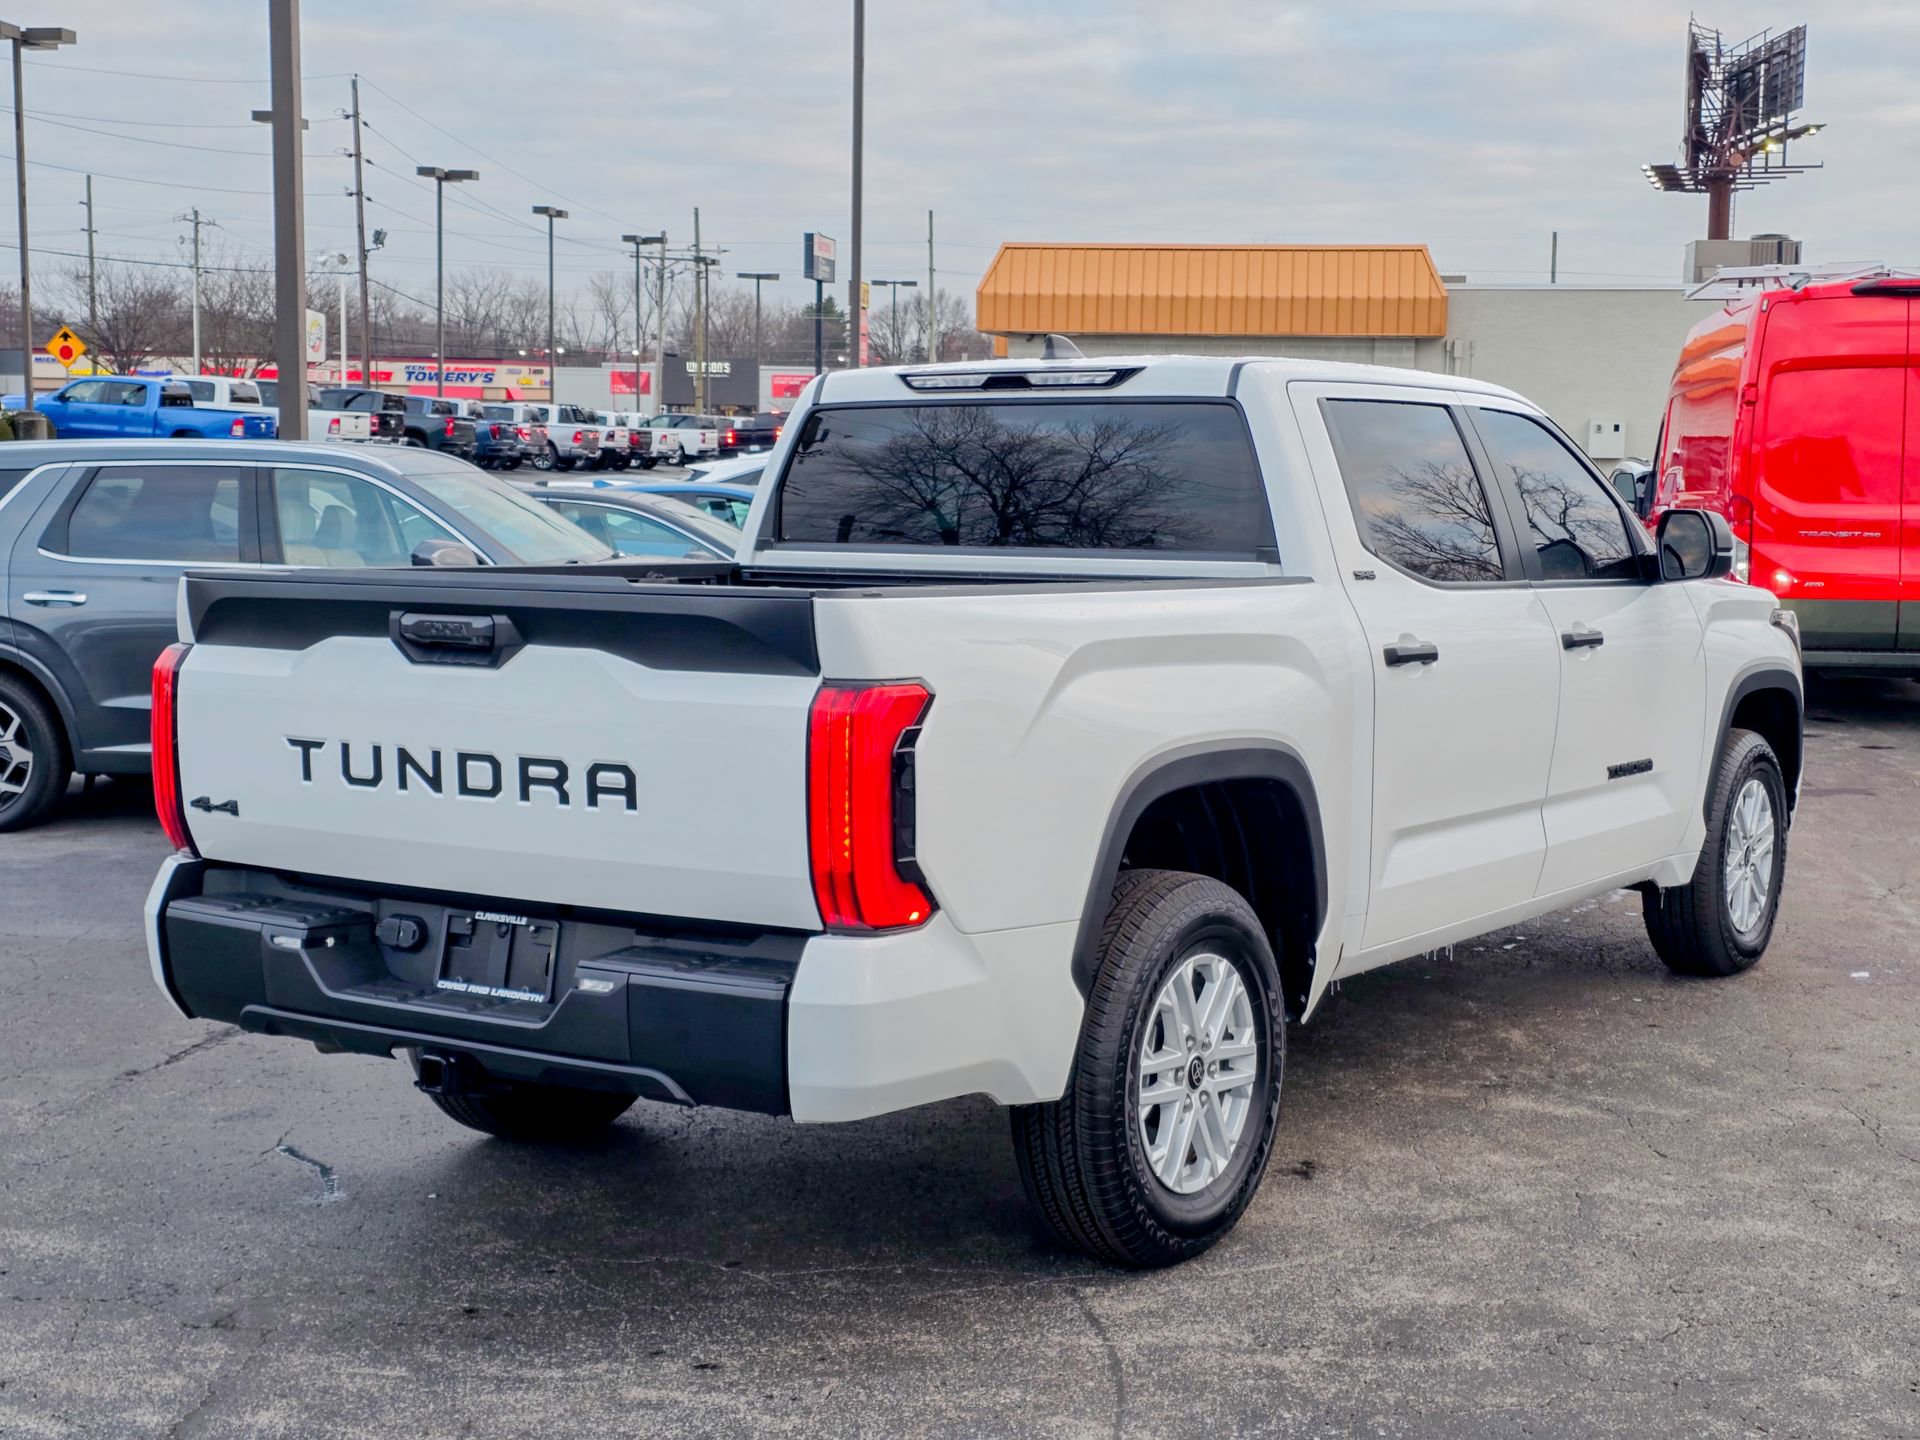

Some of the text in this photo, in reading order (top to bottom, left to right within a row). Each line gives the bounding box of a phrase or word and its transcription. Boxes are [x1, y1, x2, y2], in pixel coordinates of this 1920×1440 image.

[686, 361, 731, 373] WTSON'S
[405, 371, 495, 383] TOWERY'S
[1799, 530, 1861, 538] TRANSIT
[286, 736, 639, 813] TUNDRA
[1606, 757, 1654, 780] TUNDRA
[474, 911, 528, 926] CLARKSVILLE
[436, 980, 465, 992] CRAIG
[467, 983, 490, 995] AND
